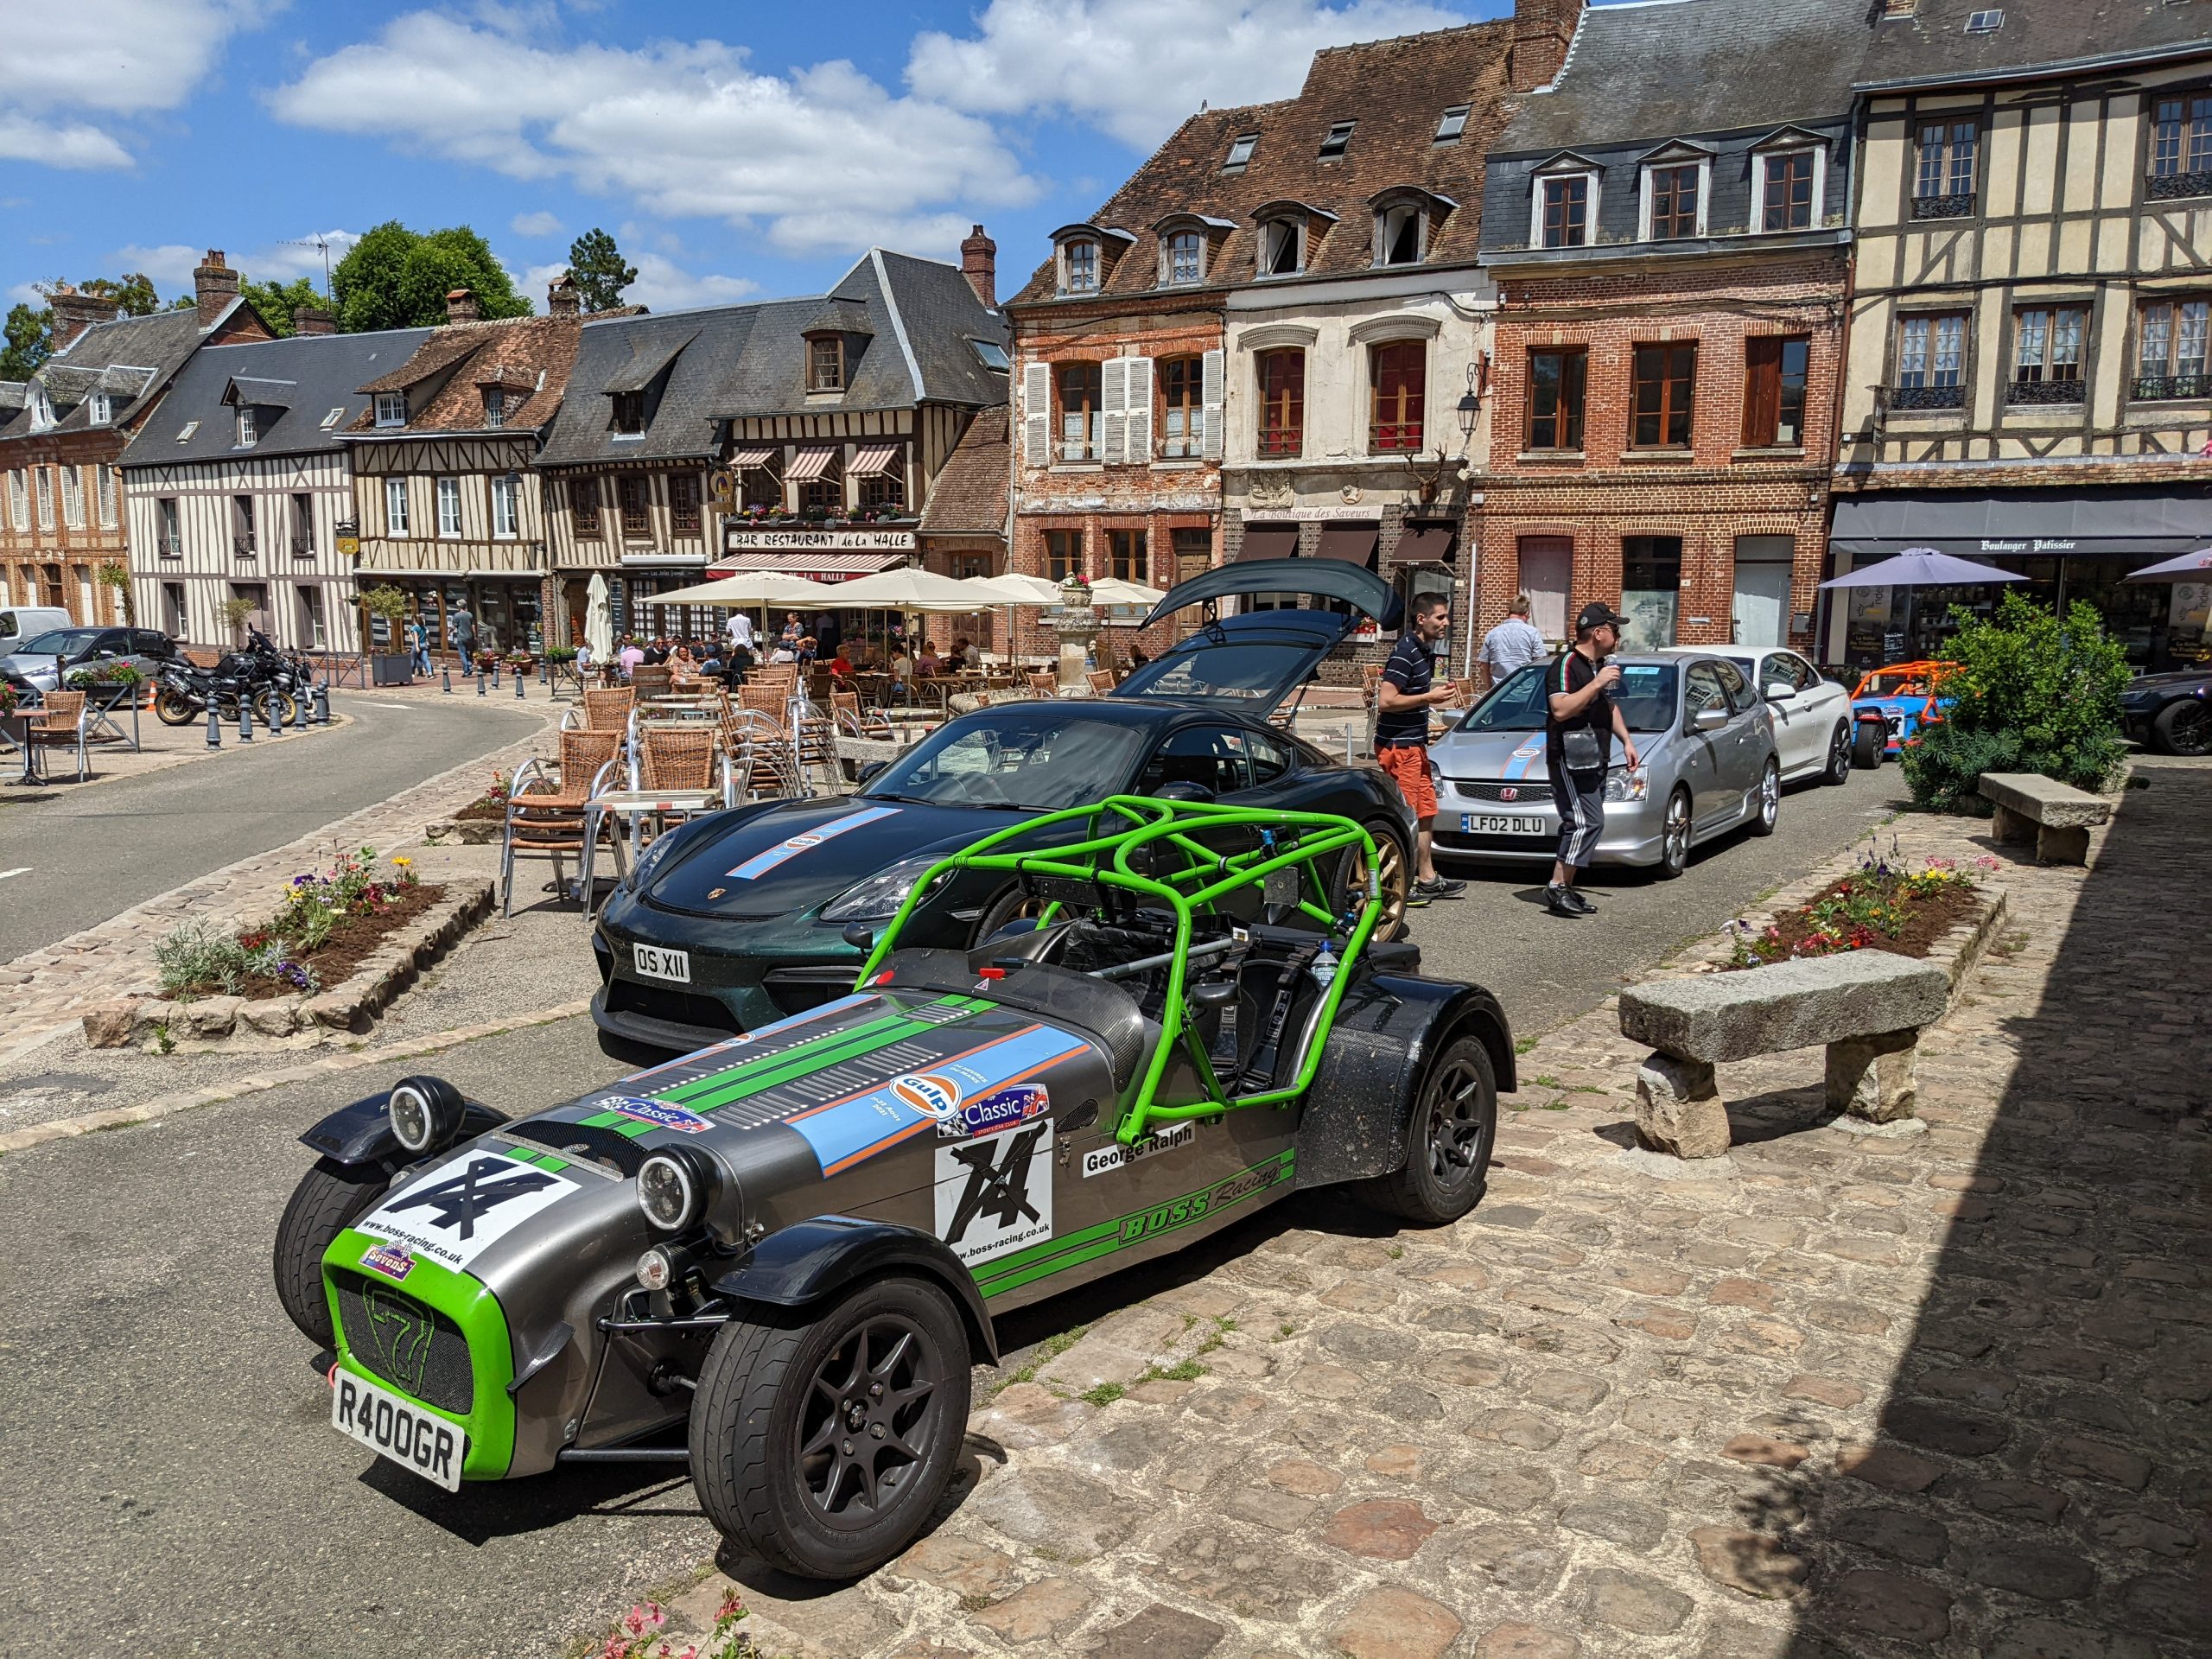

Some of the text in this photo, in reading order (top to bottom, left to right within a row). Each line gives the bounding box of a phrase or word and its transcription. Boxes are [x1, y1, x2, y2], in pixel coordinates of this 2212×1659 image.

[1271, 509, 1313, 520] Boutique
[1315, 508, 1330, 518] des
[1332, 508, 1370, 518] Saveurs
[737, 534, 758, 546] BAR
[764, 534, 834, 546] RESTAURANT
[873, 534, 907, 546] HALLE
[1980, 540, 2027, 552] Boulanger
[821, 573, 846, 582] HALLE
[1471, 817, 1508, 831] LF02
[1512, 818, 1541, 832] DLU
[903, 1077, 948, 1112] Gulp
[624, 1102, 679, 1122] Classic
[872, 1103, 887, 1116] 2021
[964, 1096, 1021, 1125] Classic
[977, 1127, 994, 1135] SPORTS
[1086, 1125, 1192, 1173] George Ralph
[1122, 1166, 1279, 1242] BOSS Racing
[362, 1218, 464, 1265] www.boss-racing.co.uk
[339, 1378, 454, 1480] R400GR
